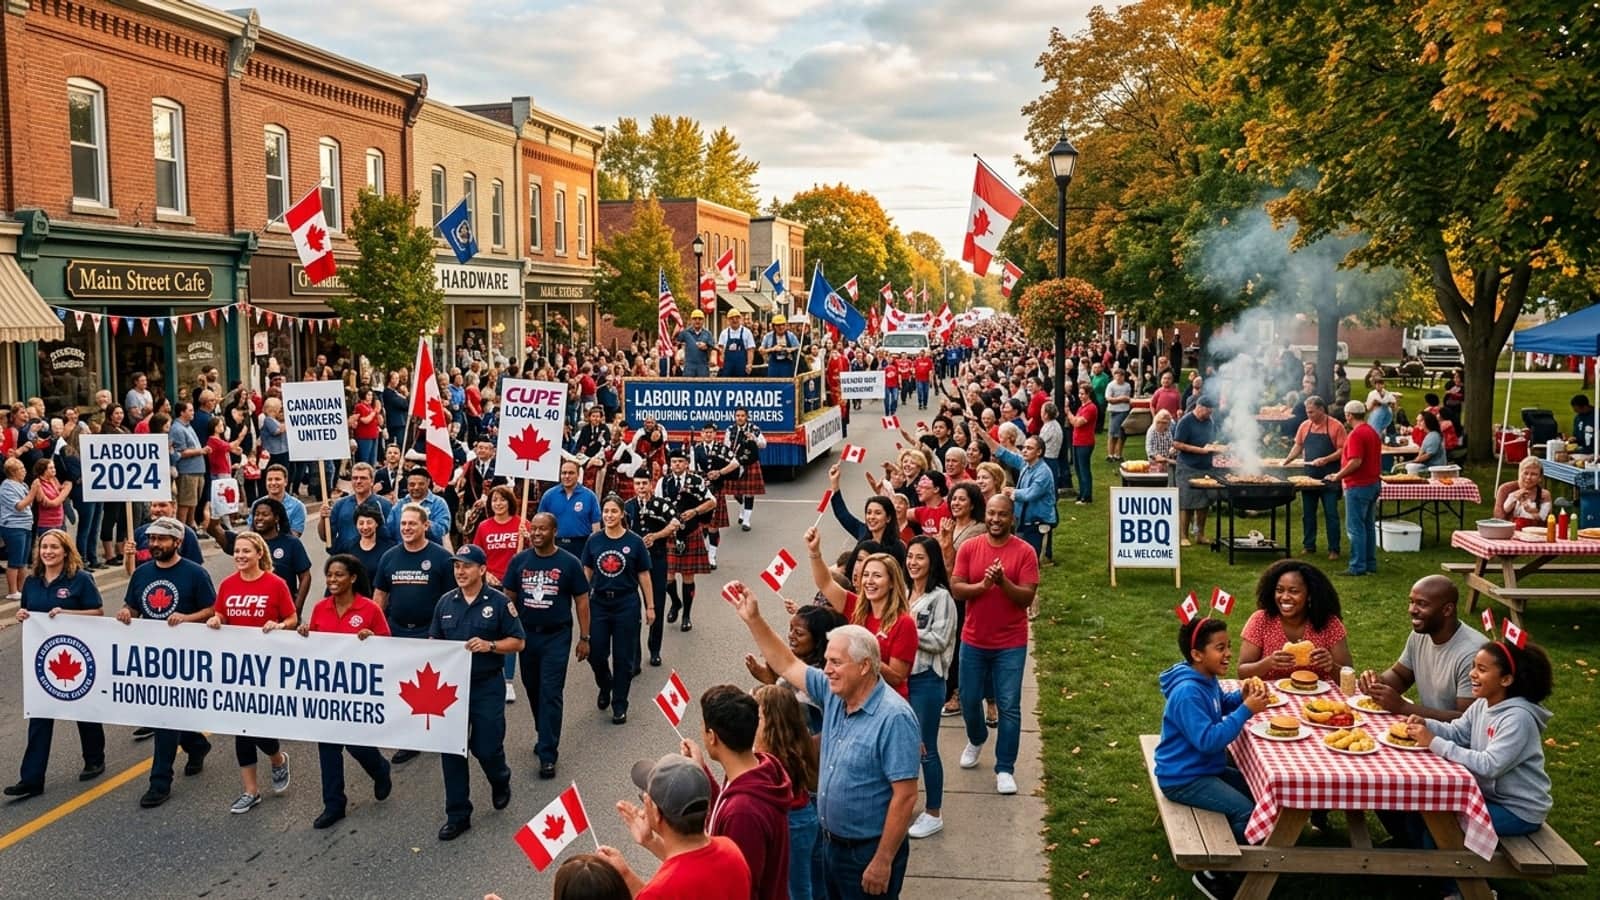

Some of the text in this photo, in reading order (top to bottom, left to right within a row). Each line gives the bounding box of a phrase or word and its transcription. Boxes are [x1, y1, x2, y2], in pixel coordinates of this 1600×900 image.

[79, 268, 206, 292] Main Street Cafe
[441, 269, 509, 290] HARDWARE
[287, 397, 342, 412] CANADIAN
[506, 387, 562, 406] CUPE
[635, 389, 783, 408] LABOUR DAY PARADE
[289, 412, 343, 427] WORKERS
[505, 405, 560, 421] LOCAL 40
[298, 428, 337, 441] UNITED
[89, 443, 160, 460] LABOUR
[90, 462, 161, 490] 2024
[1119, 496, 1172, 515] UNION
[486, 533, 518, 543] CUPE
[1120, 519, 1170, 546] BBQ
[1117, 549, 1173, 559] ALL WELCOME
[226, 595, 269, 608] CUPE
[112, 644, 213, 683] LABOUR
[221, 652, 272, 687] DAY
[280, 656, 384, 696] PARADE
[112, 681, 208, 710] HONOURING
[213, 689, 297, 717] CANADIAN
[302, 697, 385, 725] WORKERS
